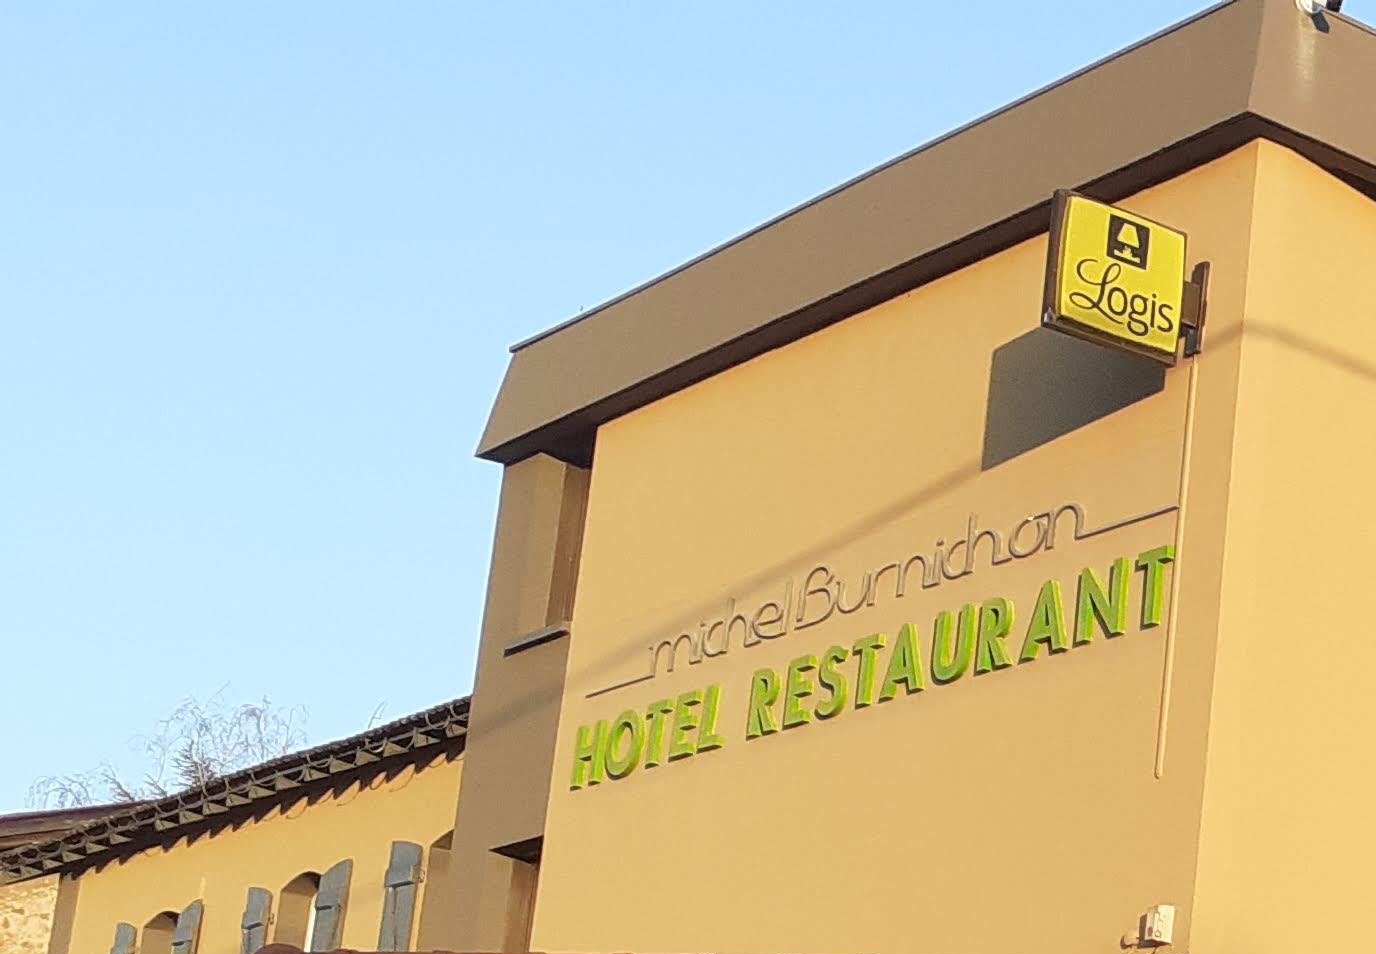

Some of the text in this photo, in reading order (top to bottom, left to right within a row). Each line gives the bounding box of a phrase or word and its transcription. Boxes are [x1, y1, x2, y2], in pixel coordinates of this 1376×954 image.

[1069, 258, 1174, 336] Logis
[569, 544, 1176, 791] HOTEL RESTAURANT
